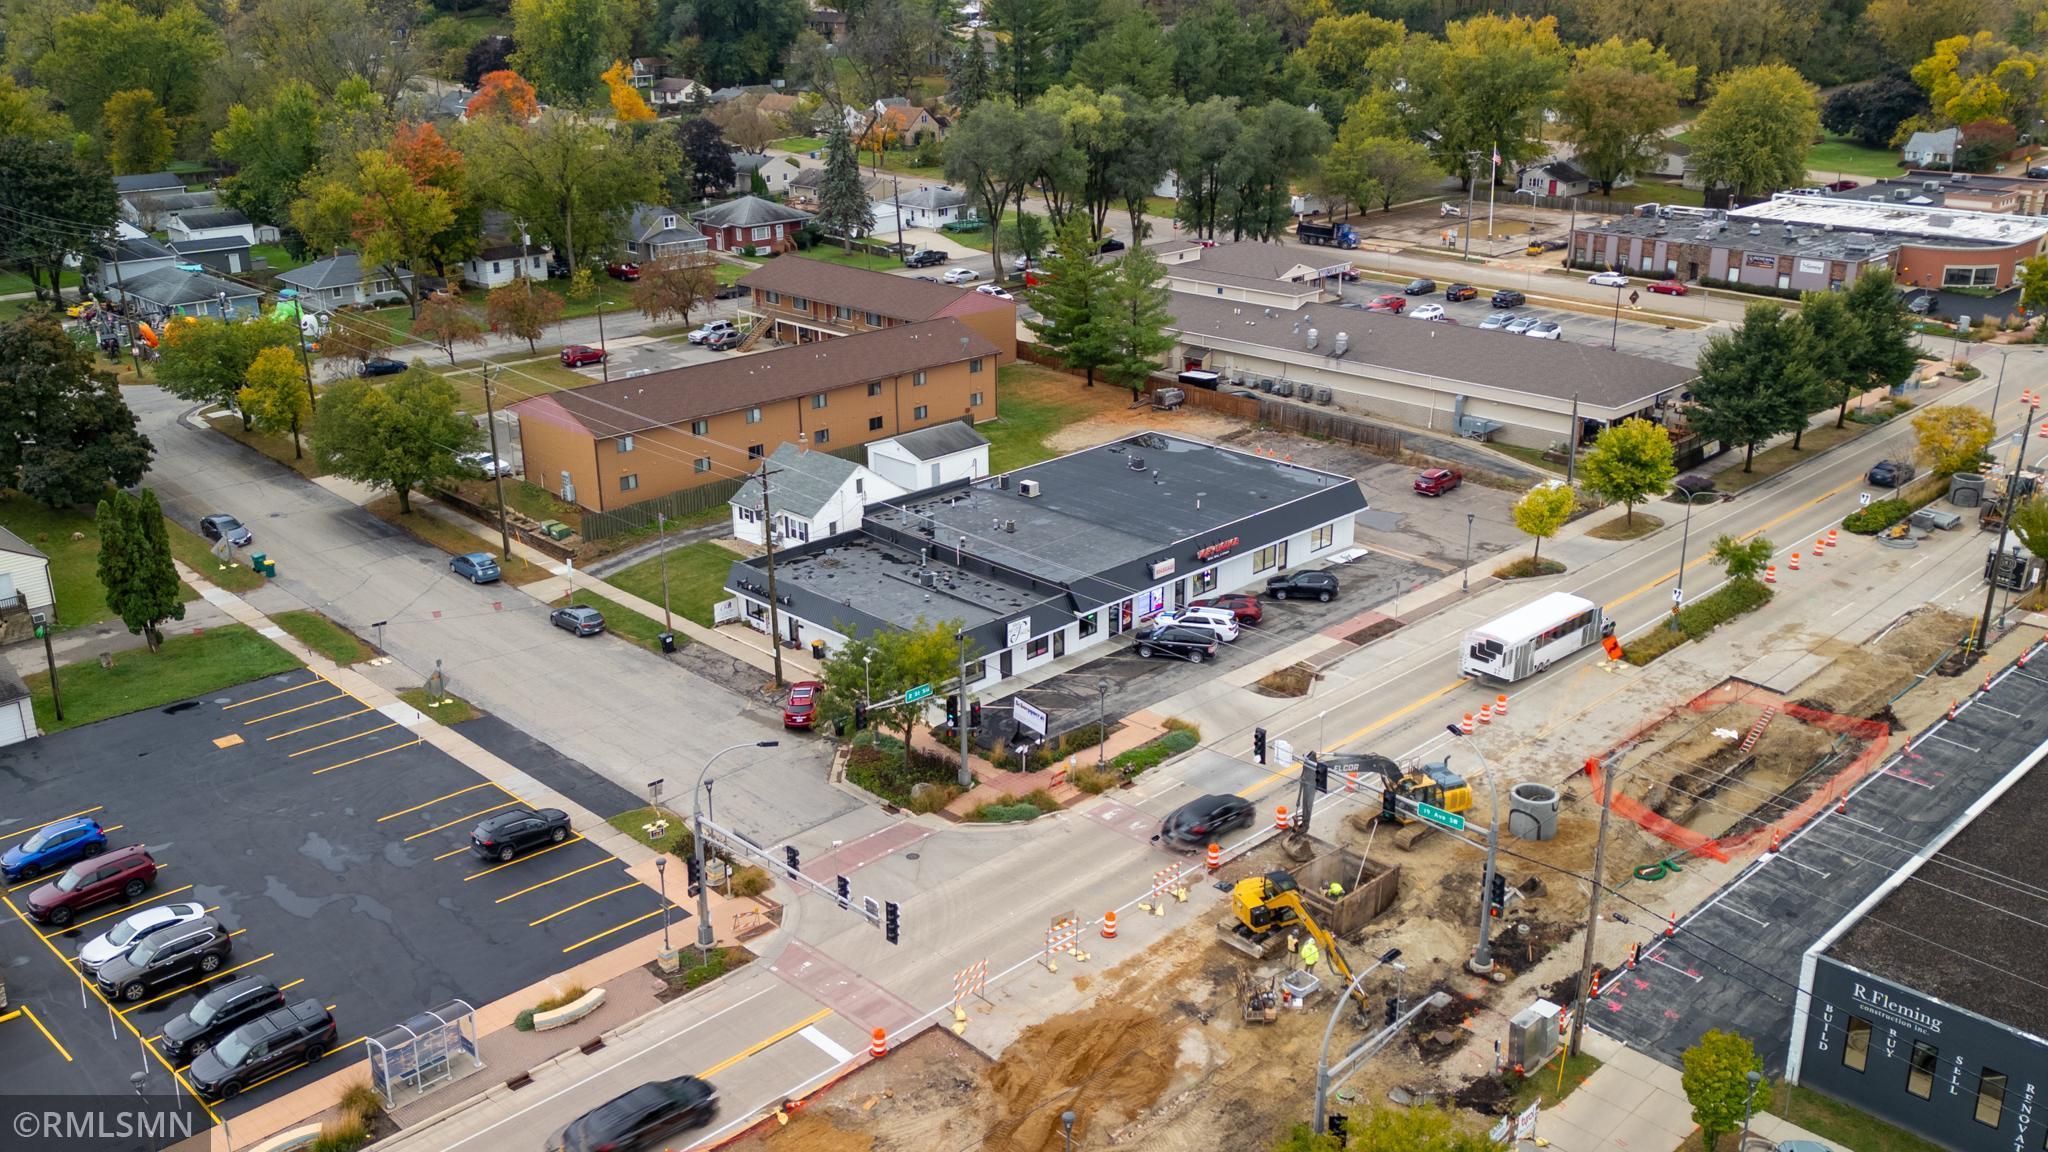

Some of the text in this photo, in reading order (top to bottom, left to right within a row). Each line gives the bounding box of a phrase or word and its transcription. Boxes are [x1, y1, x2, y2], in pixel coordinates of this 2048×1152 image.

[1423, 808, 1459, 825] 19 Ave SW
[1818, 1003, 1834, 1051] BUILD
[1859, 1003, 1931, 1036] construction inc.
[1949, 1055, 1964, 1096] SELL
